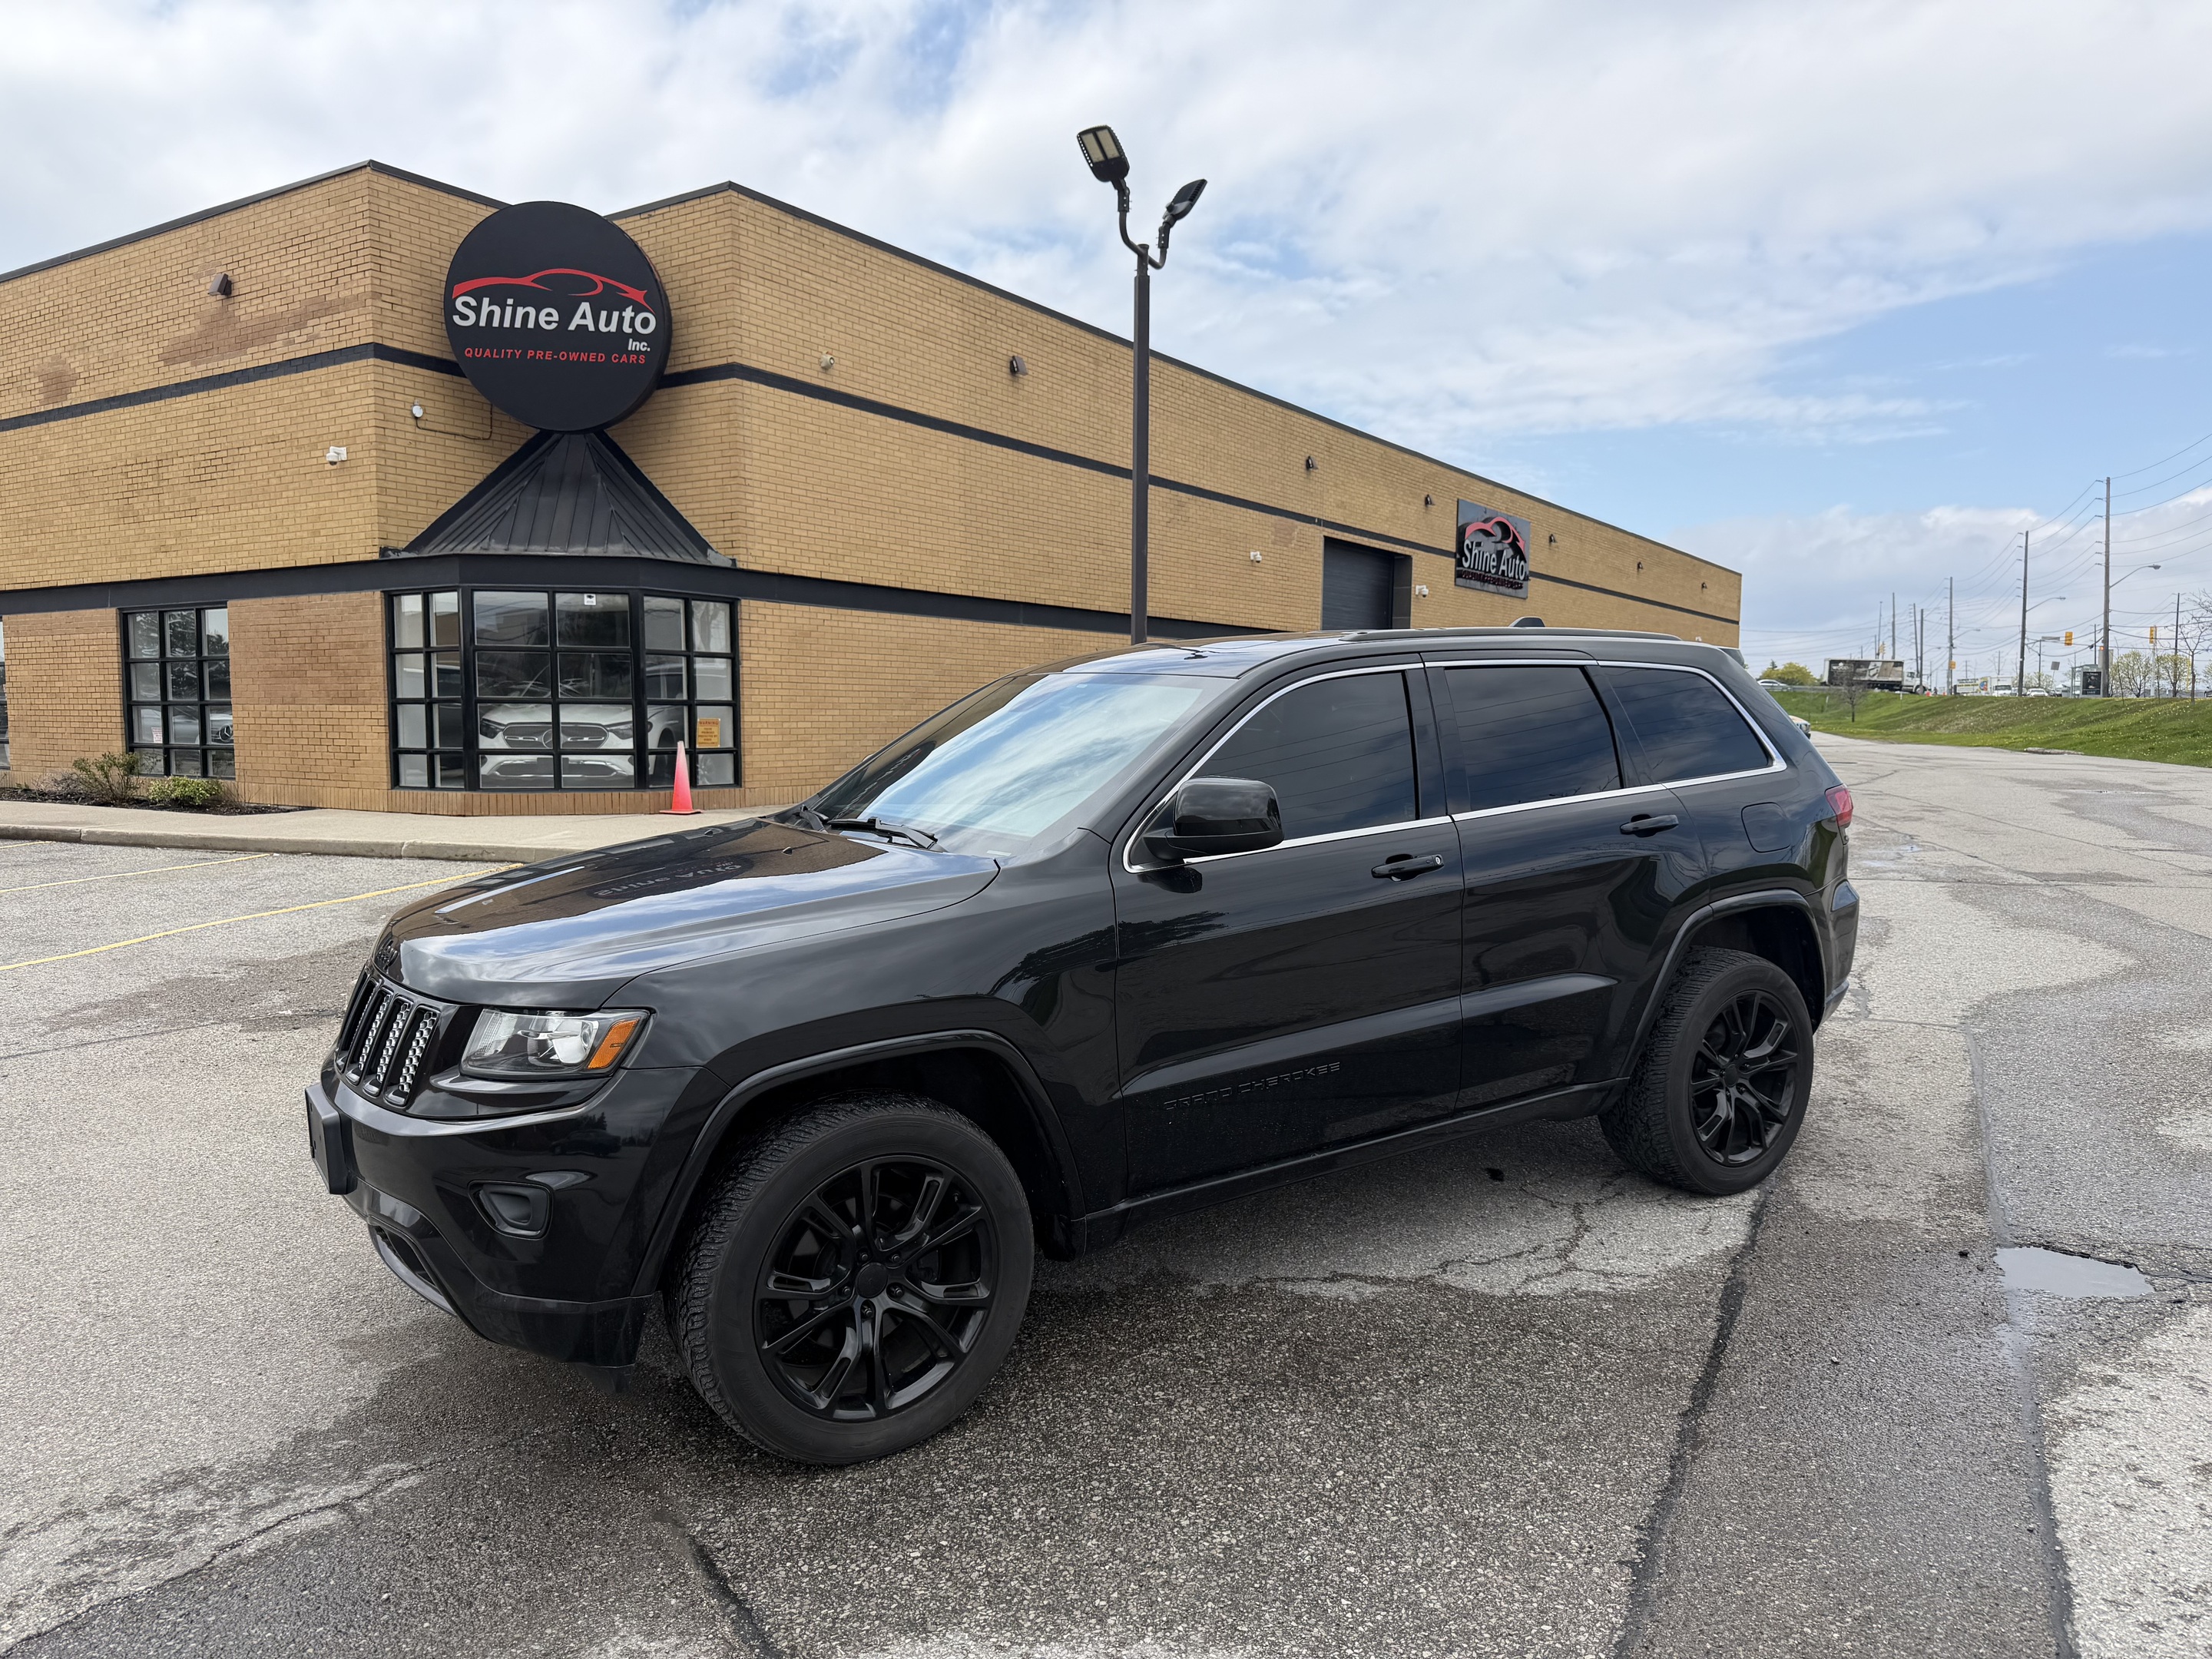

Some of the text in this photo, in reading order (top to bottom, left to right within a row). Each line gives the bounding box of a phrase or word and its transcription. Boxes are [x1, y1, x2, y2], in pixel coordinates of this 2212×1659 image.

[452, 296, 657, 335] Shine Auto
[464, 347, 646, 364] QUALITY PRE-OWNED CARS
[628, 338, 651, 352] Inc.
[1462, 539, 1497, 573] Shine
[1498, 549, 1525, 581] Auto
[1163, 1061, 1341, 1111] GRAND CHEROKEE
